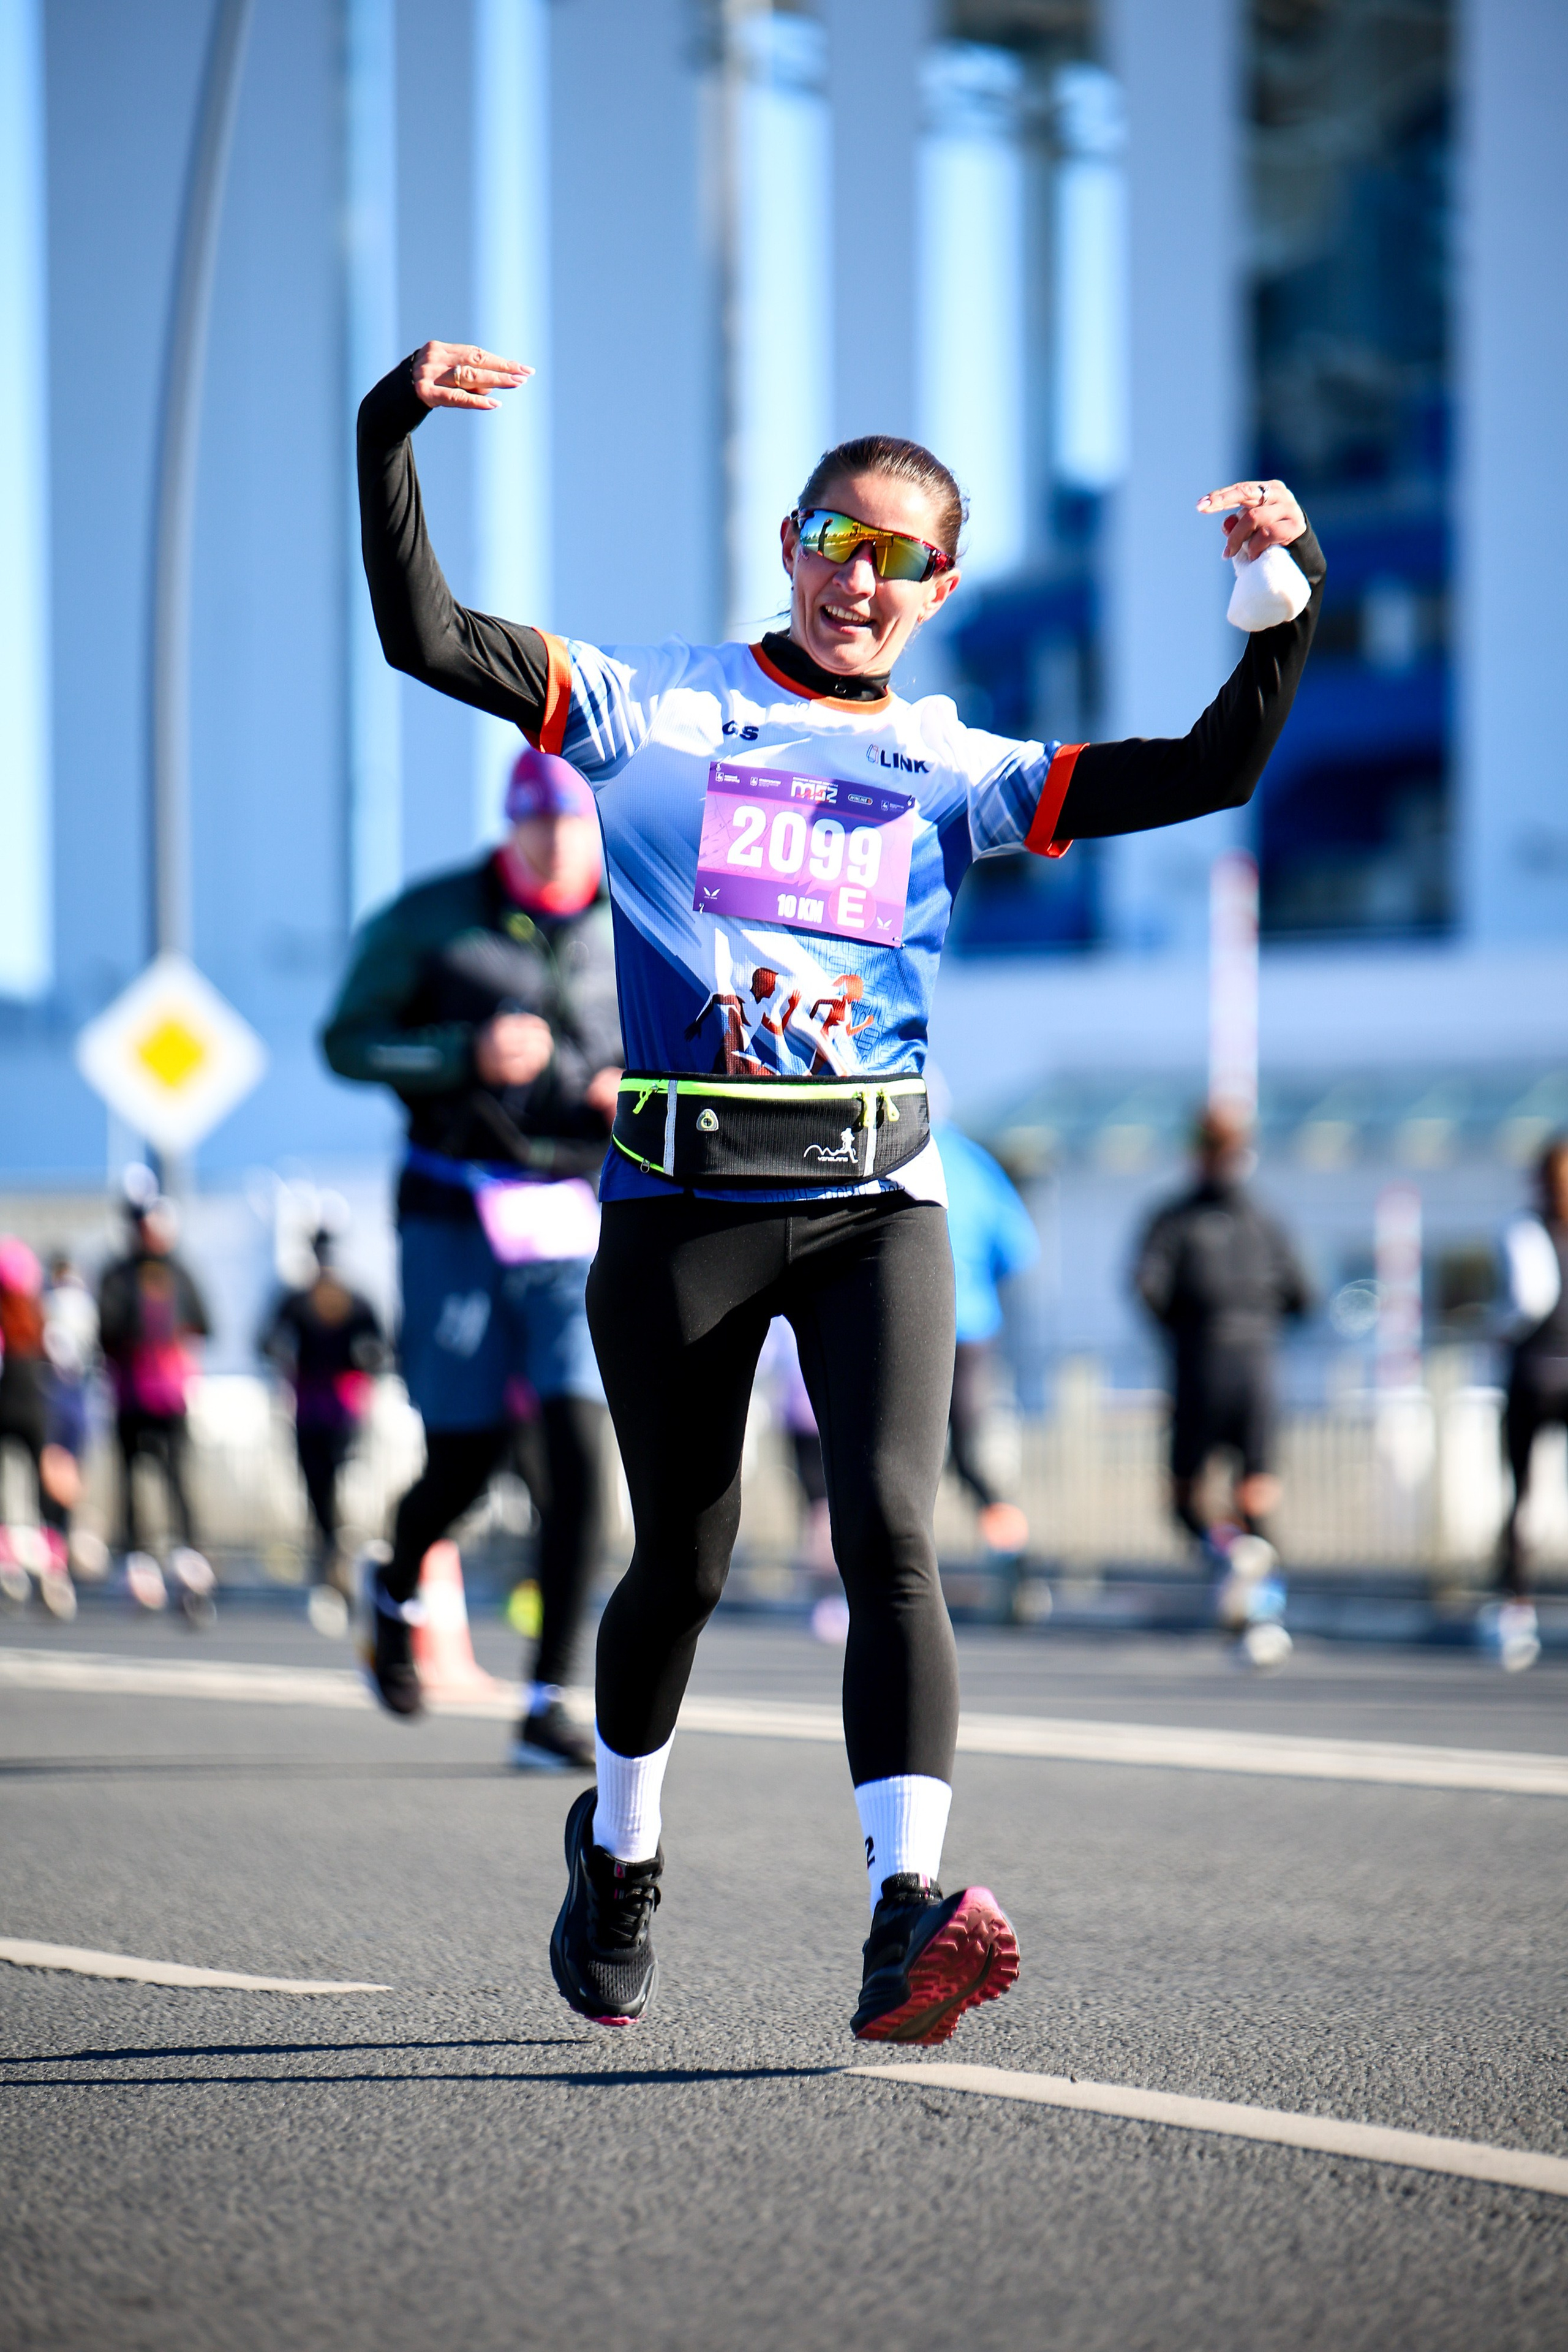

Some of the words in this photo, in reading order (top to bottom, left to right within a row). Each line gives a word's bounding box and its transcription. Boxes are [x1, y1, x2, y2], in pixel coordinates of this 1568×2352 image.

[880, 749, 930, 774] LINK
[850, 795, 867, 804] WINLINE
[726, 805, 883, 889] 2099
[777, 894, 796, 918] 10
[837, 887, 867, 929] E
